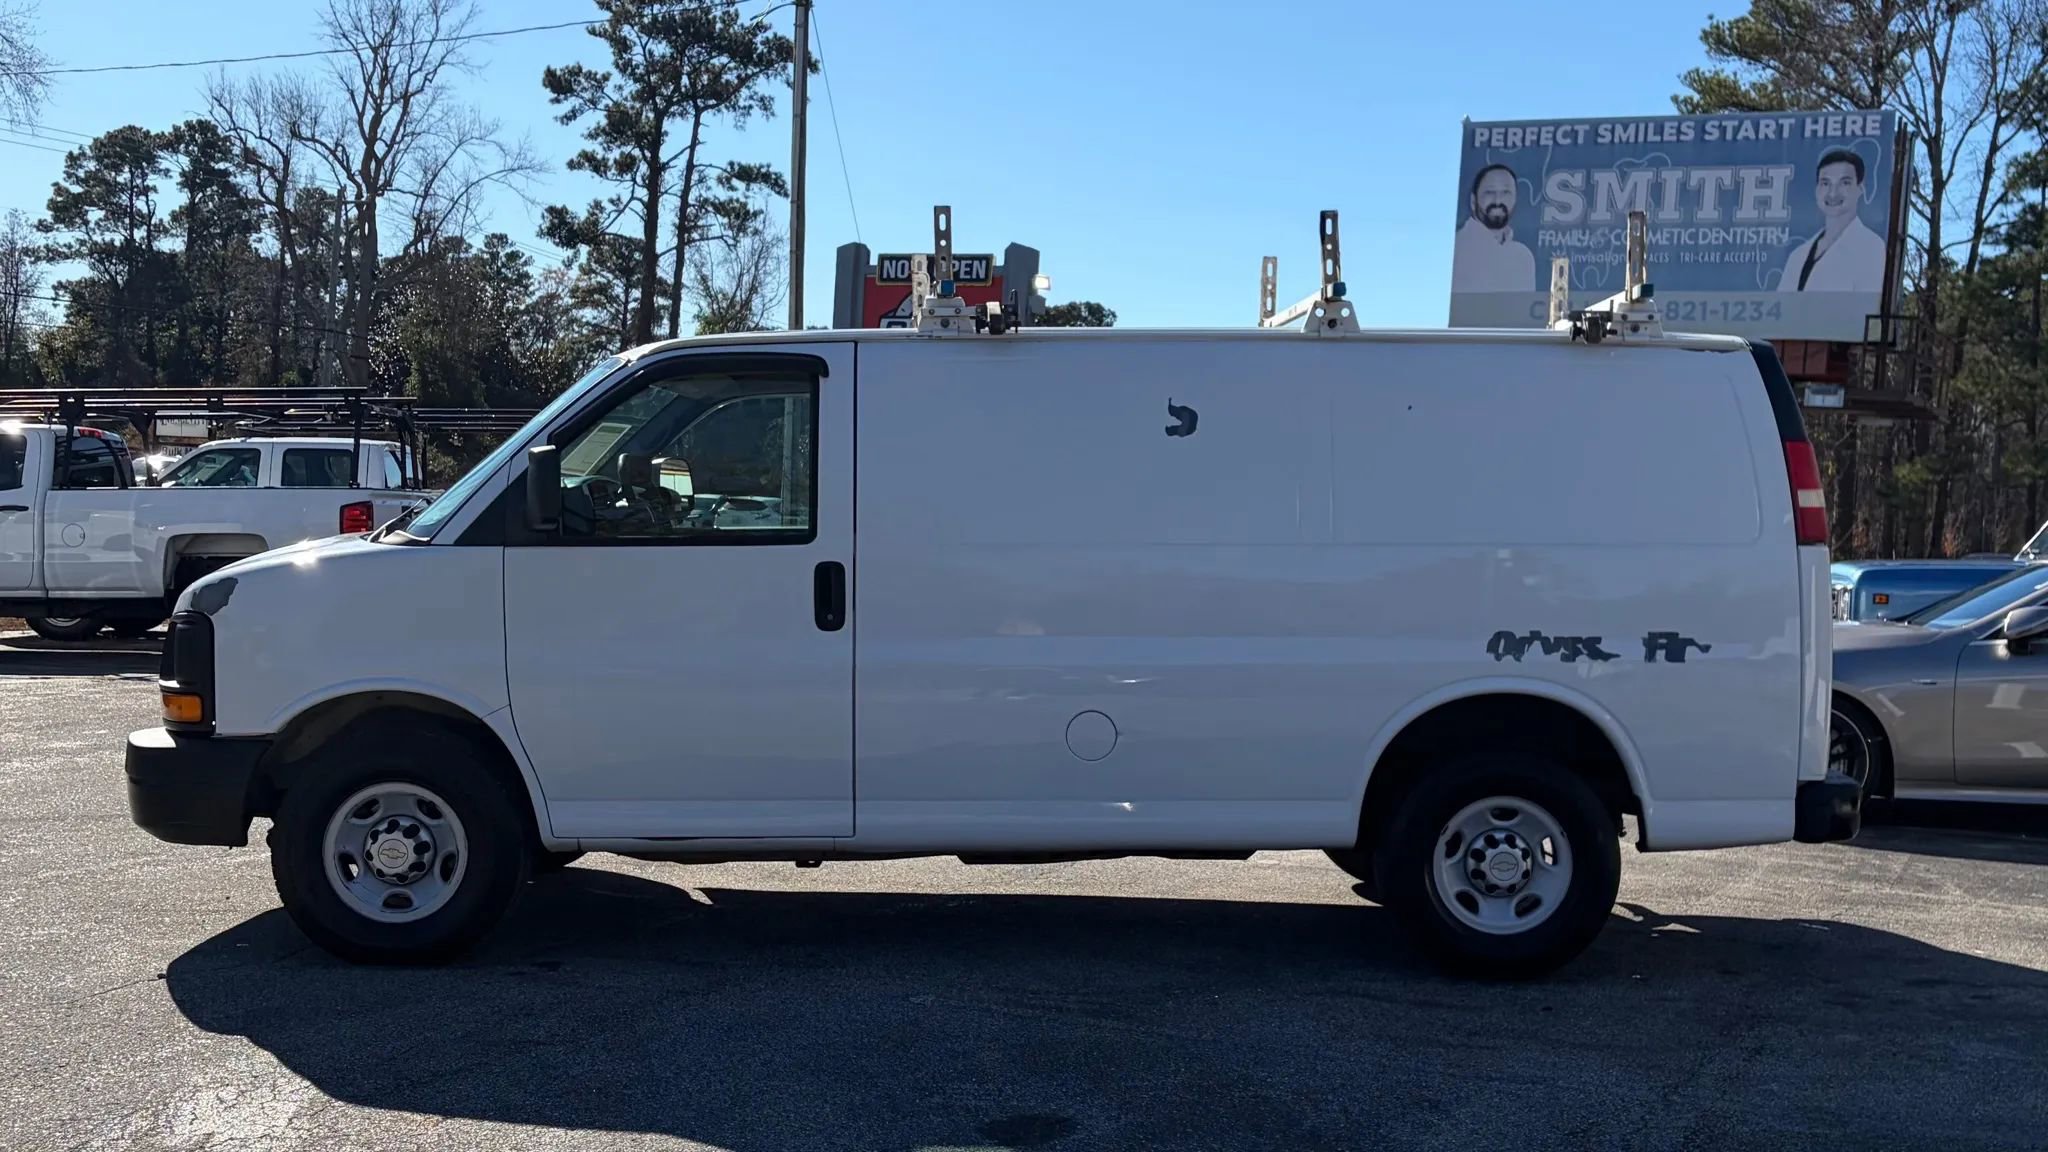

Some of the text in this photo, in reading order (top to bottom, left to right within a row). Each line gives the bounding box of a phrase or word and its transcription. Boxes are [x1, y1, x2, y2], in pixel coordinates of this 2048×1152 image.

[1474, 114, 1882, 148] PERFECT SMILES START HERE
[1541, 165, 1794, 225] SMITH
[1538, 228, 1590, 248] FAMILY
[1699, 226, 1790, 246] DENTISTRY
[1680, 252, 1720, 264] TRI-CARE
[1724, 251, 1767, 264] ACCEPTED
[882, 259, 922, 280] NO
